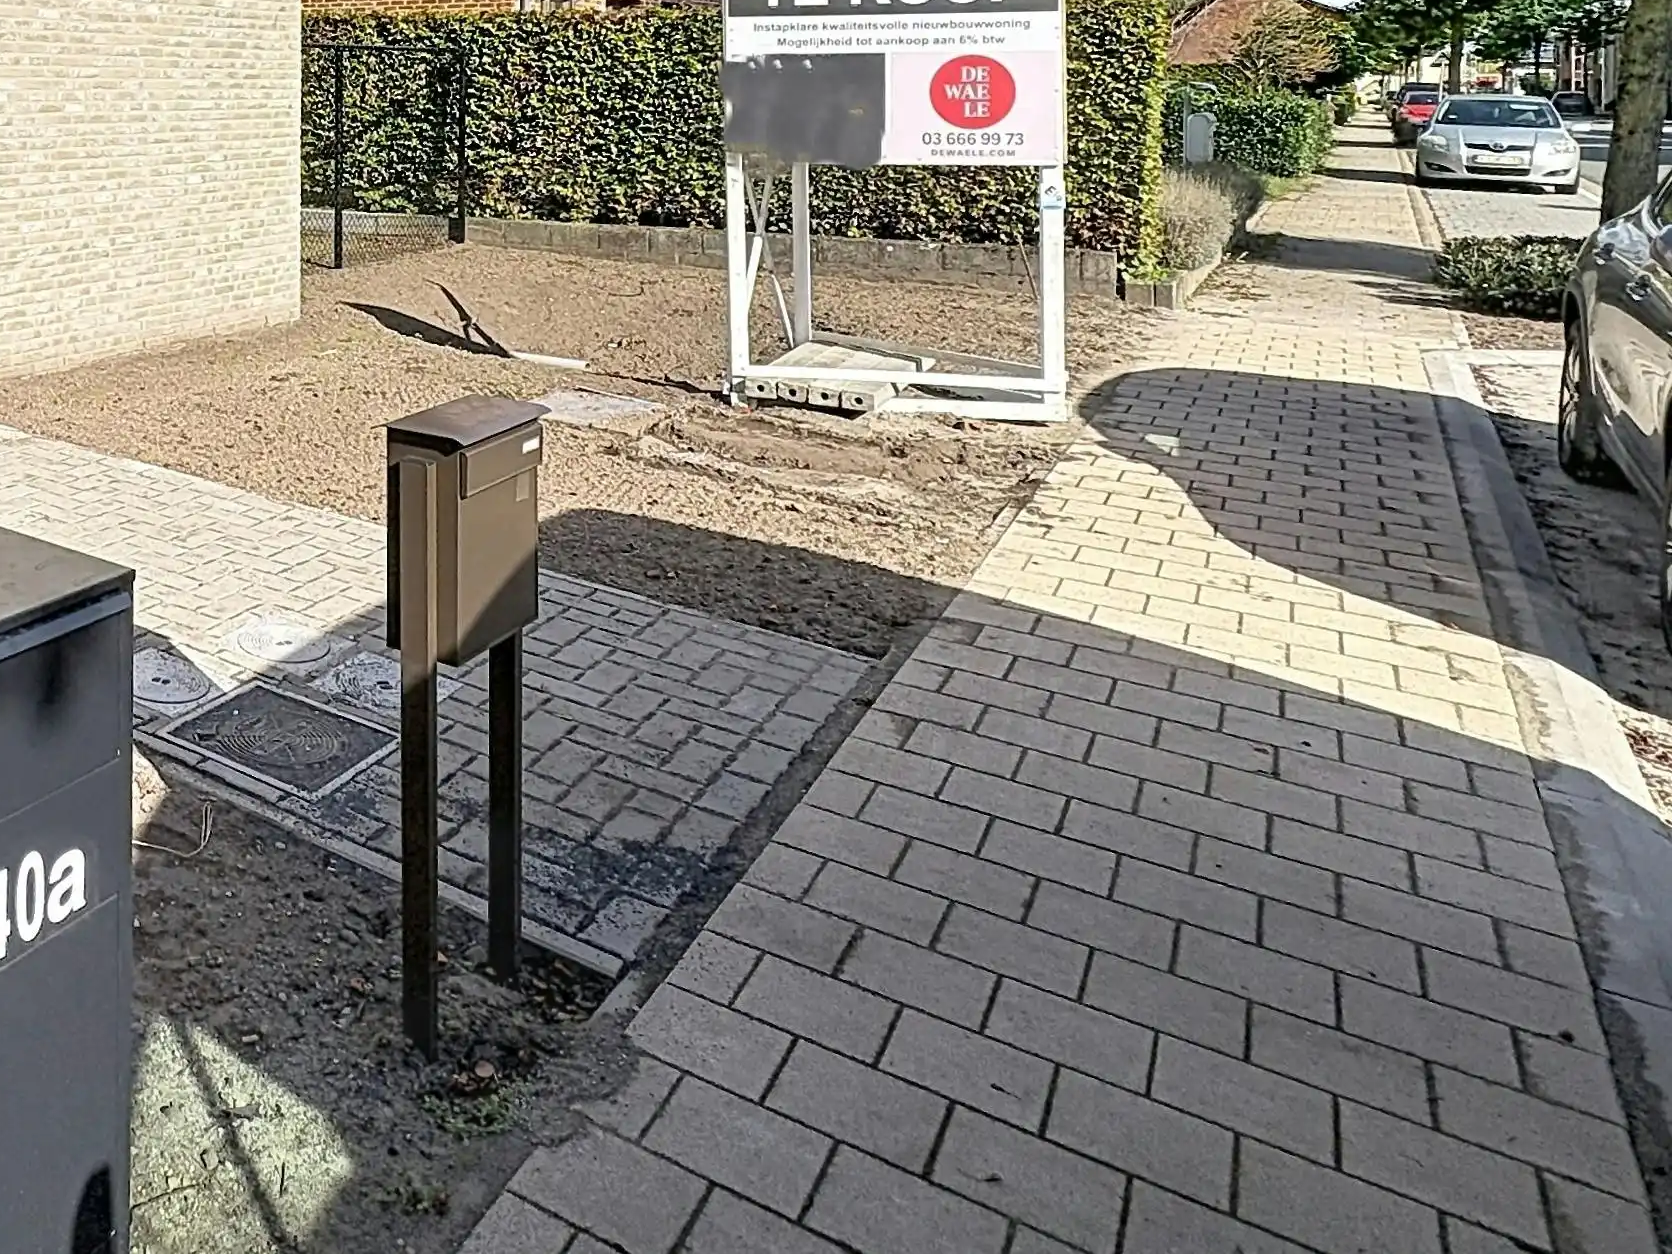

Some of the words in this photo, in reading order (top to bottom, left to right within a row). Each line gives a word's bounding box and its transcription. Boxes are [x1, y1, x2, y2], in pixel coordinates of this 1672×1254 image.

[753, 23, 819, 33] Instapklare
[822, 21, 909, 31] kwaliteitsvolle
[912, 18, 1031, 30] nieuwbouwwoning
[777, 37, 853, 48] Mogelijkheid
[856, 37, 873, 46] tot
[876, 36, 930, 47] aankoop
[933, 36, 956, 45] aan
[959, 35, 978, 45] 6%
[982, 35, 1006, 44] btw
[961, 66, 991, 82] DE
[944, 84, 991, 100] WAE
[964, 101, 991, 118] LE
[922, 132, 942, 146] 03
[946, 132, 977, 146] 666
[980, 132, 1001, 146] 99
[1005, 132, 1025, 146] 73
